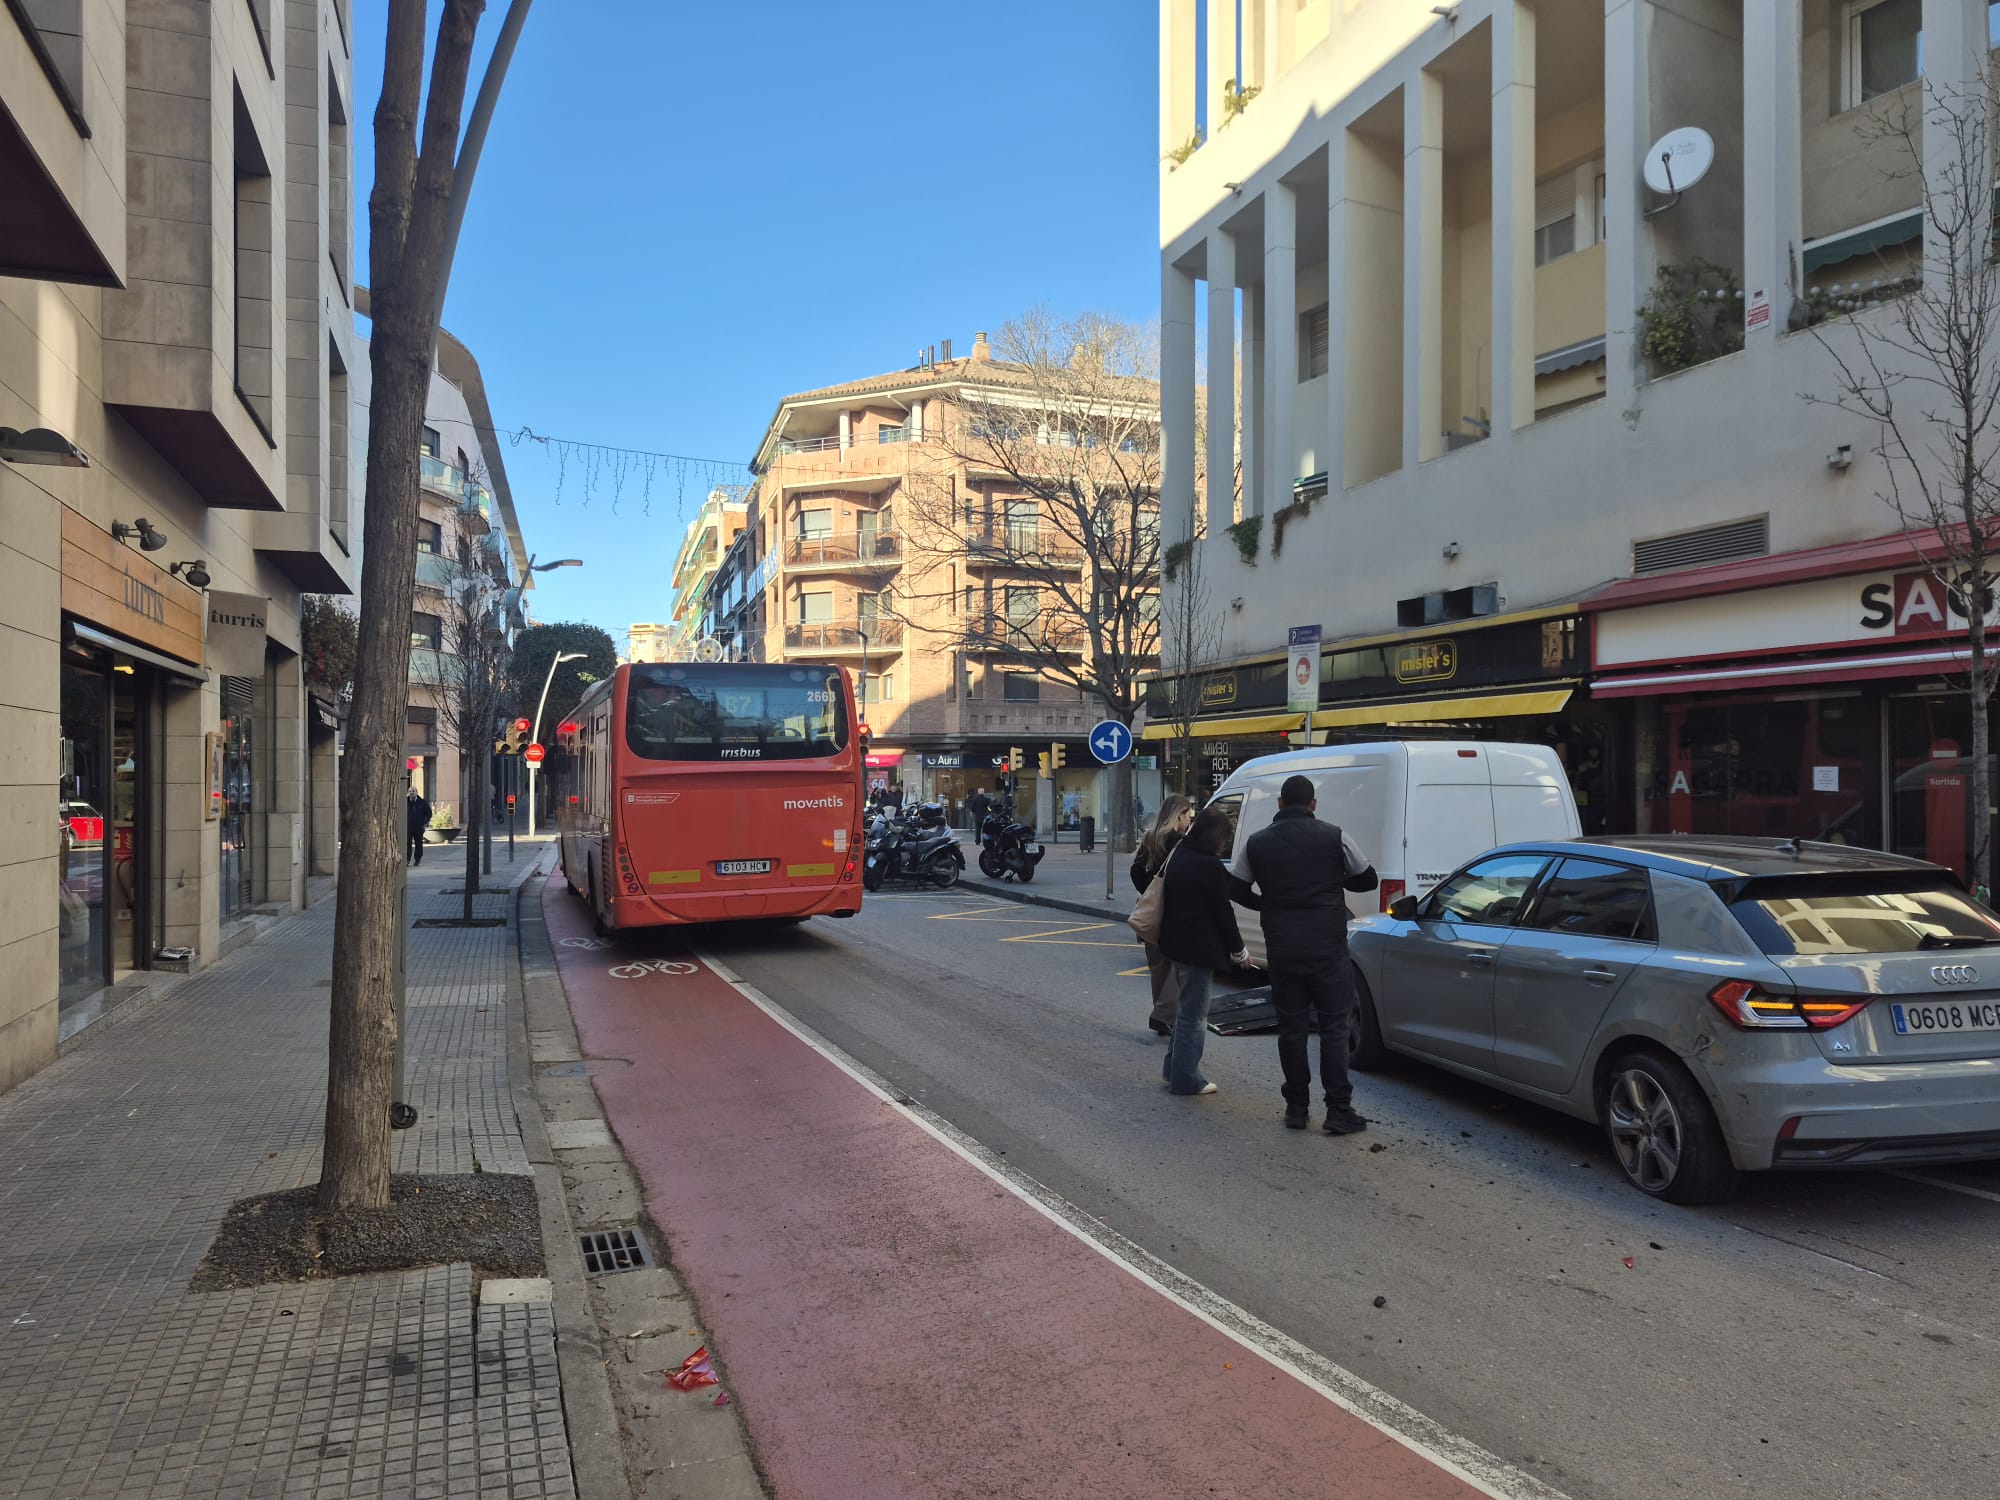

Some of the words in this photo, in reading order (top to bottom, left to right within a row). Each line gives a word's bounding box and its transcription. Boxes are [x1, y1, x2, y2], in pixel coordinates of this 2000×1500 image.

[211, 608, 265, 628] turris
[720, 747, 761, 758] irisbus
[937, 754, 960, 765] Aural
[1929, 776, 1961, 786] Sortida
[783, 795, 844, 810] moventis
[723, 862, 747, 872] 6103
[750, 861, 768, 871] HCW
[1908, 1006, 1963, 1030] 0608
